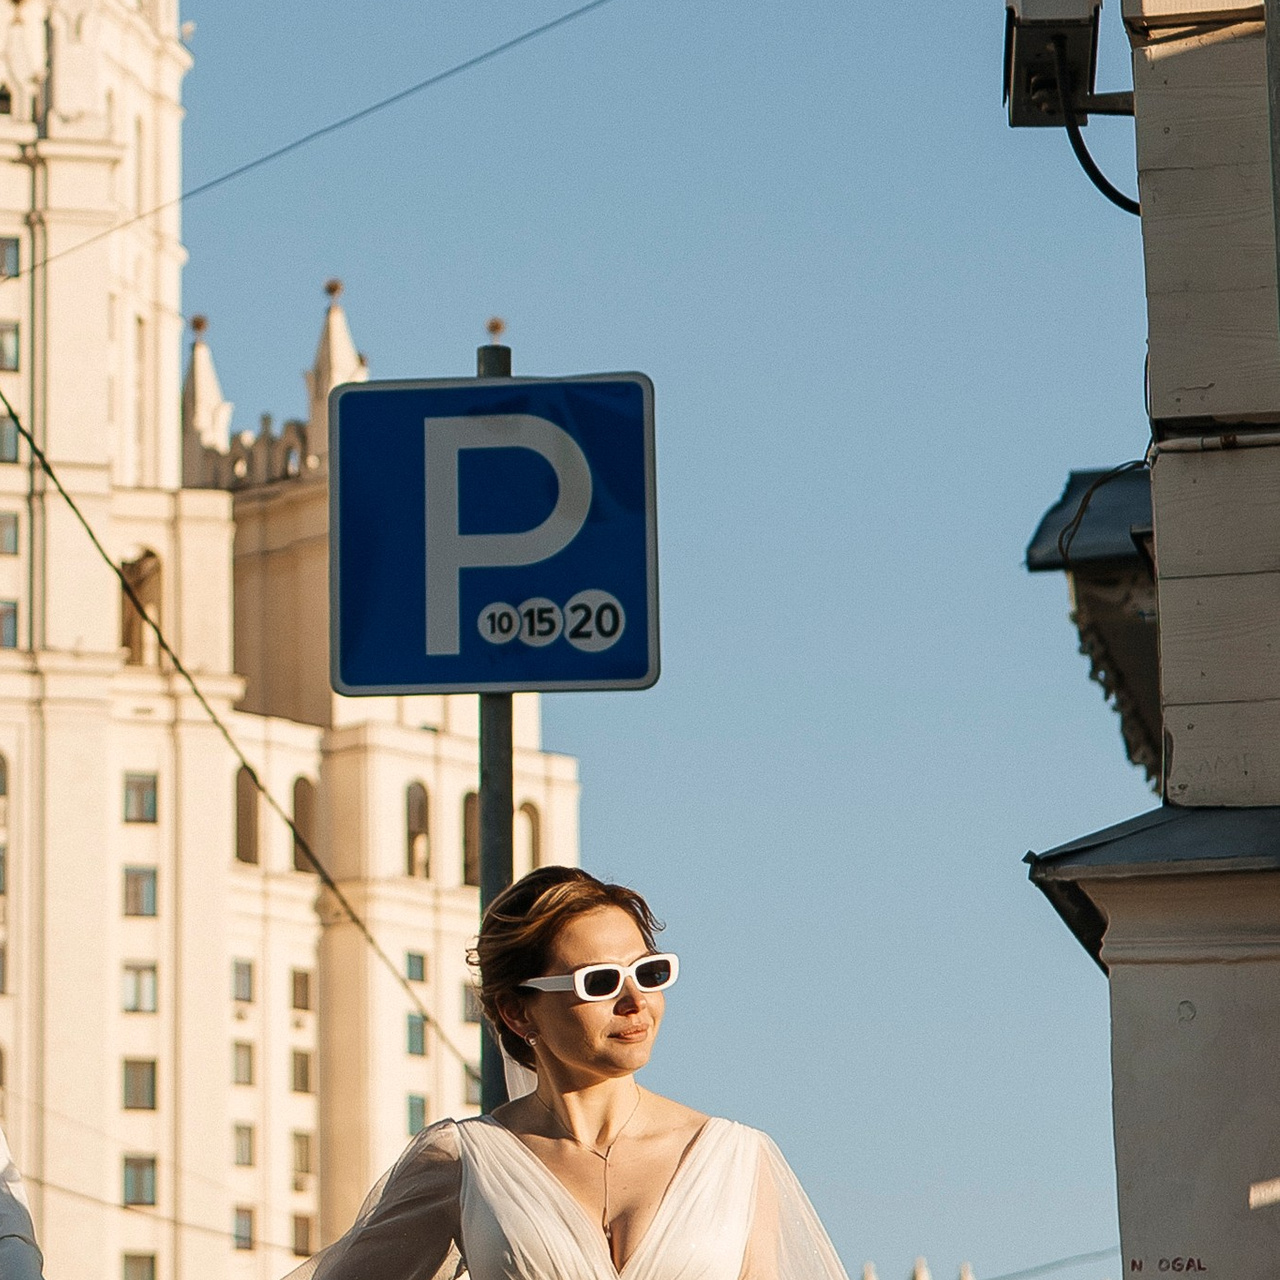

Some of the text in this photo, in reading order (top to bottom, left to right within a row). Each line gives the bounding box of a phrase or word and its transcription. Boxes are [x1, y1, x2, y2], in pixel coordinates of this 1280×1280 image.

[424, 413, 592, 656] P
[486, 602, 621, 640] 10 15 20
